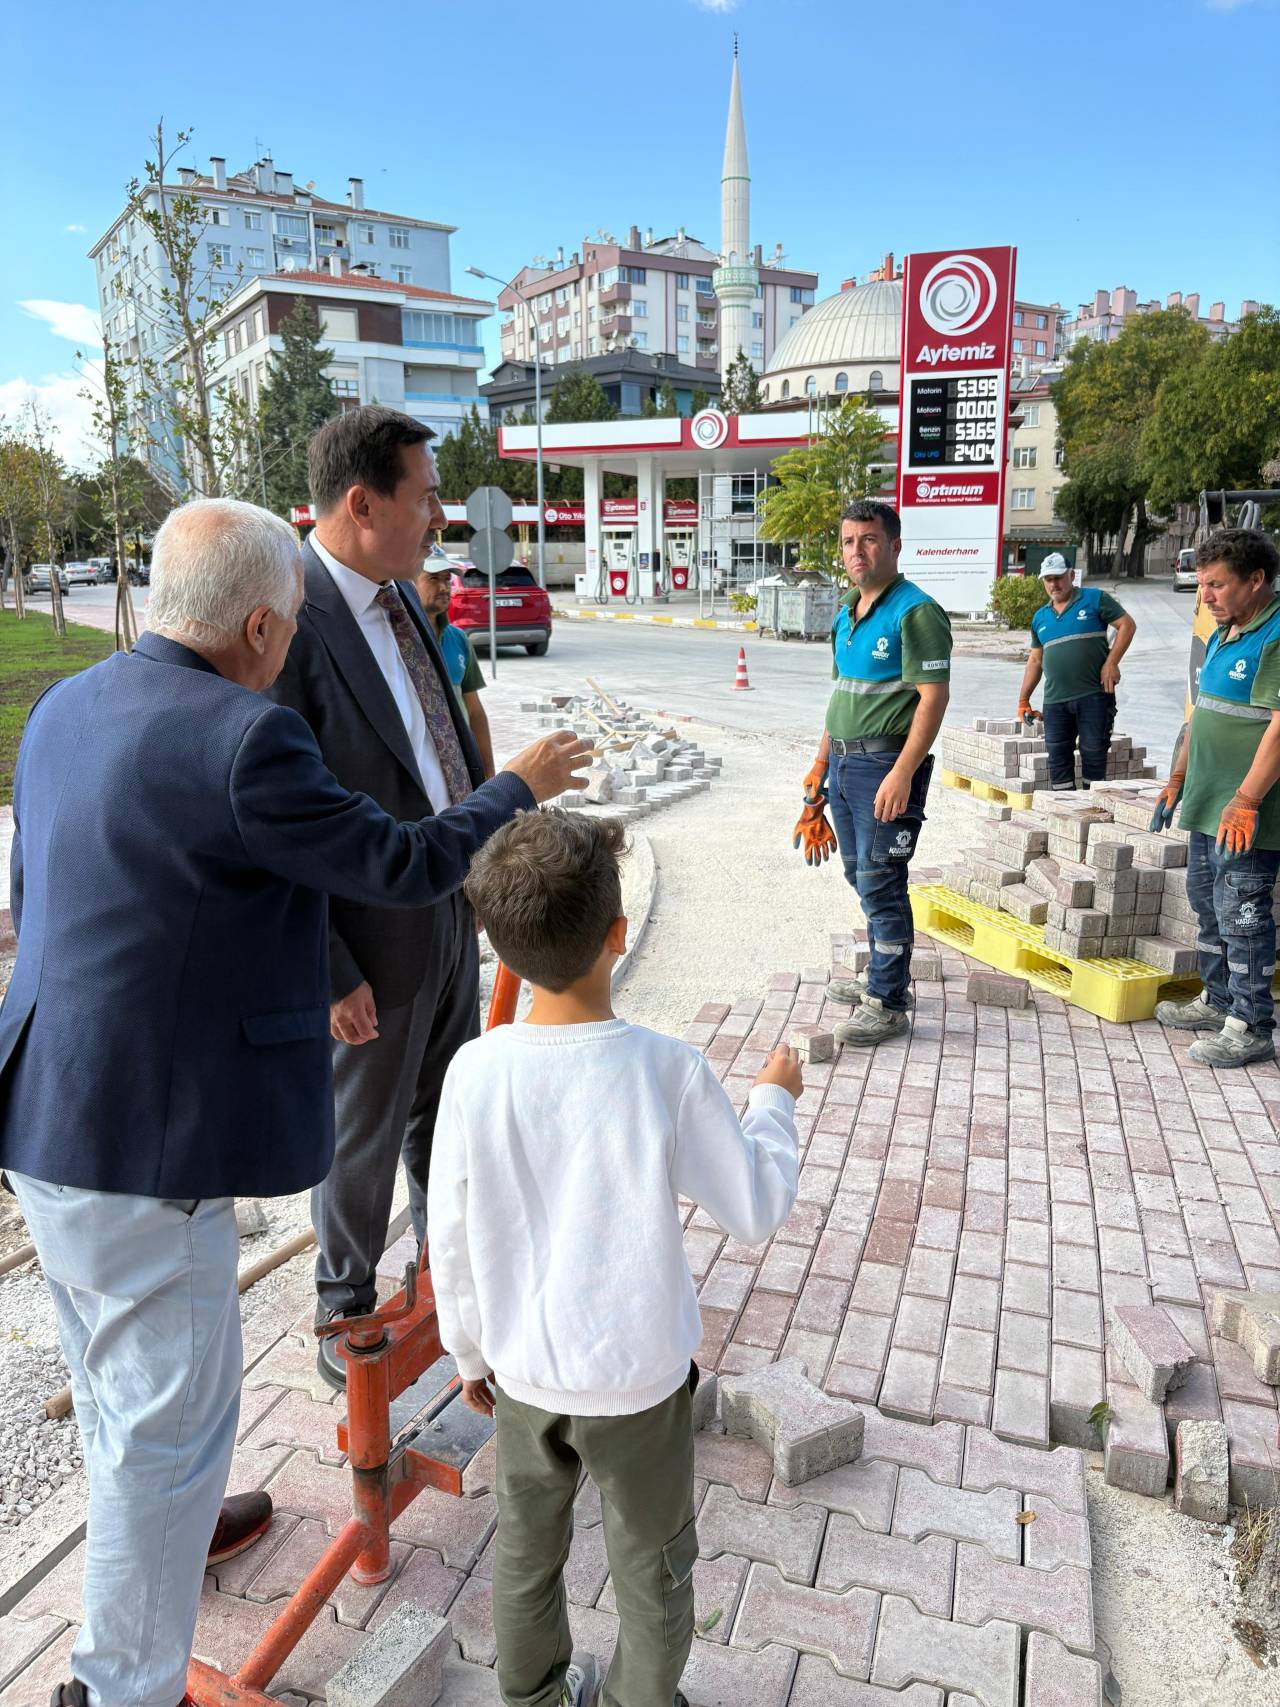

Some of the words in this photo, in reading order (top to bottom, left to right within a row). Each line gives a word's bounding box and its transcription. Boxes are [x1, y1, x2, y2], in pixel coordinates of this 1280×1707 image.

[916, 342, 996, 365] Aytemiz
[917, 387, 942, 395] Motorin
[957, 378, 998, 398] 53.99
[919, 426, 941, 434] Benzin
[955, 421, 996, 440] 53.65
[916, 548, 979, 556] Kalenderhane
